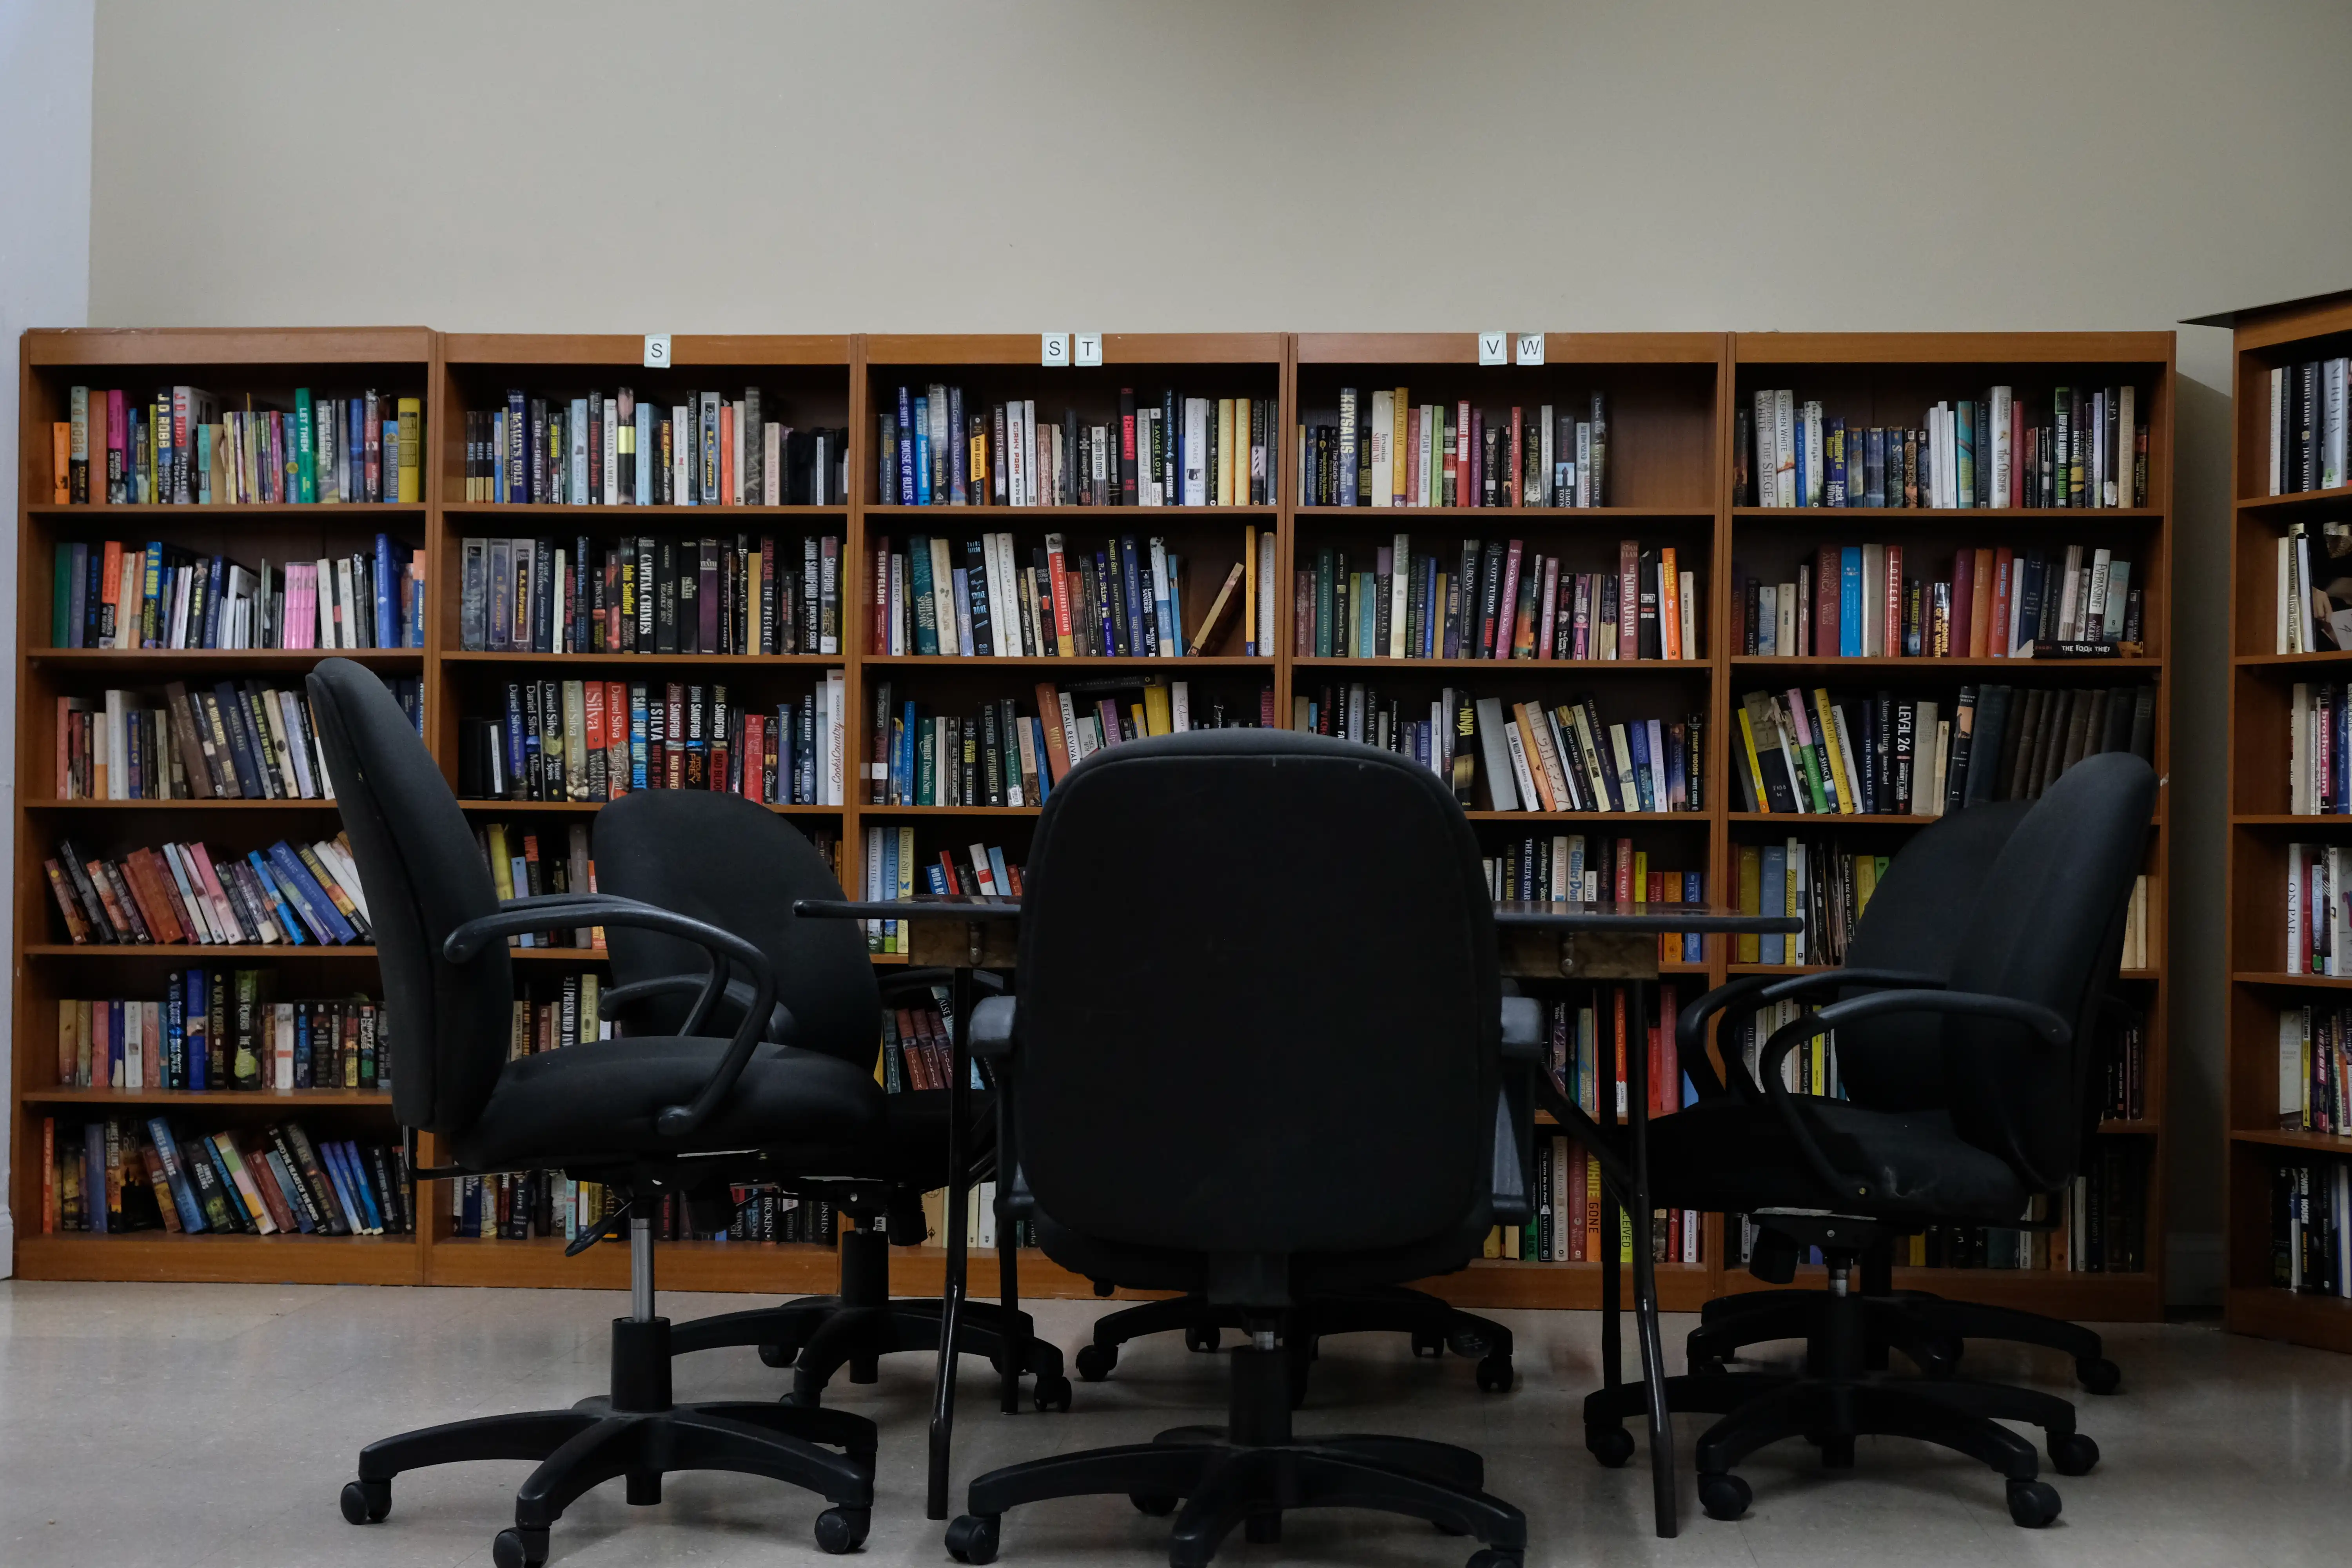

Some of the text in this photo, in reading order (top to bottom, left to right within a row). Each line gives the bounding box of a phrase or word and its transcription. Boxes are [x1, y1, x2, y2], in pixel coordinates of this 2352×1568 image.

[651, 343, 662, 358] S
[1049, 341, 1060, 356] S
[1082, 341, 1094, 356] T
[1486, 340, 1499, 355] V
[1521, 340, 1539, 355] W
[299, 408, 309, 452] LET THEM
[512, 412, 523, 457] McNALLY'S
[1339, 394, 1355, 454] KRYSALIS
[1459, 403, 1469, 461] MARGARET TRUMAN
[1757, 398, 1766, 432] WHITE
[513, 460, 523, 486] FOLLY
[1528, 436, 1538, 475] SPY DANCE
[1763, 441, 1773, 498] THE SIEGE
[1835, 485, 1844, 501] Jack
[804, 541, 818, 598] JOHN SANDFORD
[824, 557, 835, 592] SANDFORD
[877, 551, 886, 605] SEINFELDIA
[1098, 562, 1105, 570] R.
[1890, 561, 1899, 608] LOTTERY
[208, 590, 217, 615] THRONE
[622, 564, 635, 615] John Sandford
[639, 554, 652, 635] CAPITAL CRIMES
[1484, 557, 1498, 647] SCOTT TUROW TESTIMONY
[1623, 573, 1636, 636] KIROV AFFAIR
[764, 586, 773, 646] THE PRESENCE
[916, 596, 927, 626] SPELLMAN
[526, 686, 537, 735] Daniel Silva
[546, 684, 557, 736] Daniel Silva
[650, 709, 664, 741] SILVA
[669, 686, 681, 770] JOHN SANDFORD MAD
[689, 686, 702, 738] JOHN SANDFORD
[1459, 708, 1474, 736] NINJA
[1812, 716, 1820, 738] YOUNG
[1882, 700, 1890, 722] Money
[1048, 727, 1062, 750] WILD
[1063, 704, 1077, 762] RETAIL REVIVAL
[589, 754, 597, 793] WOMAN
[633, 743, 646, 789] HOLY GHOST
[1805, 749, 1819, 789] gatecrasher
[931, 867, 943, 887] NORA
[2287, 883, 2296, 934] ON PAR
[563, 992, 575, 1032] PRESUMED
[764, 1197, 773, 1233] BROKEN
[1588, 1161, 1601, 1234] WHITE GONE
